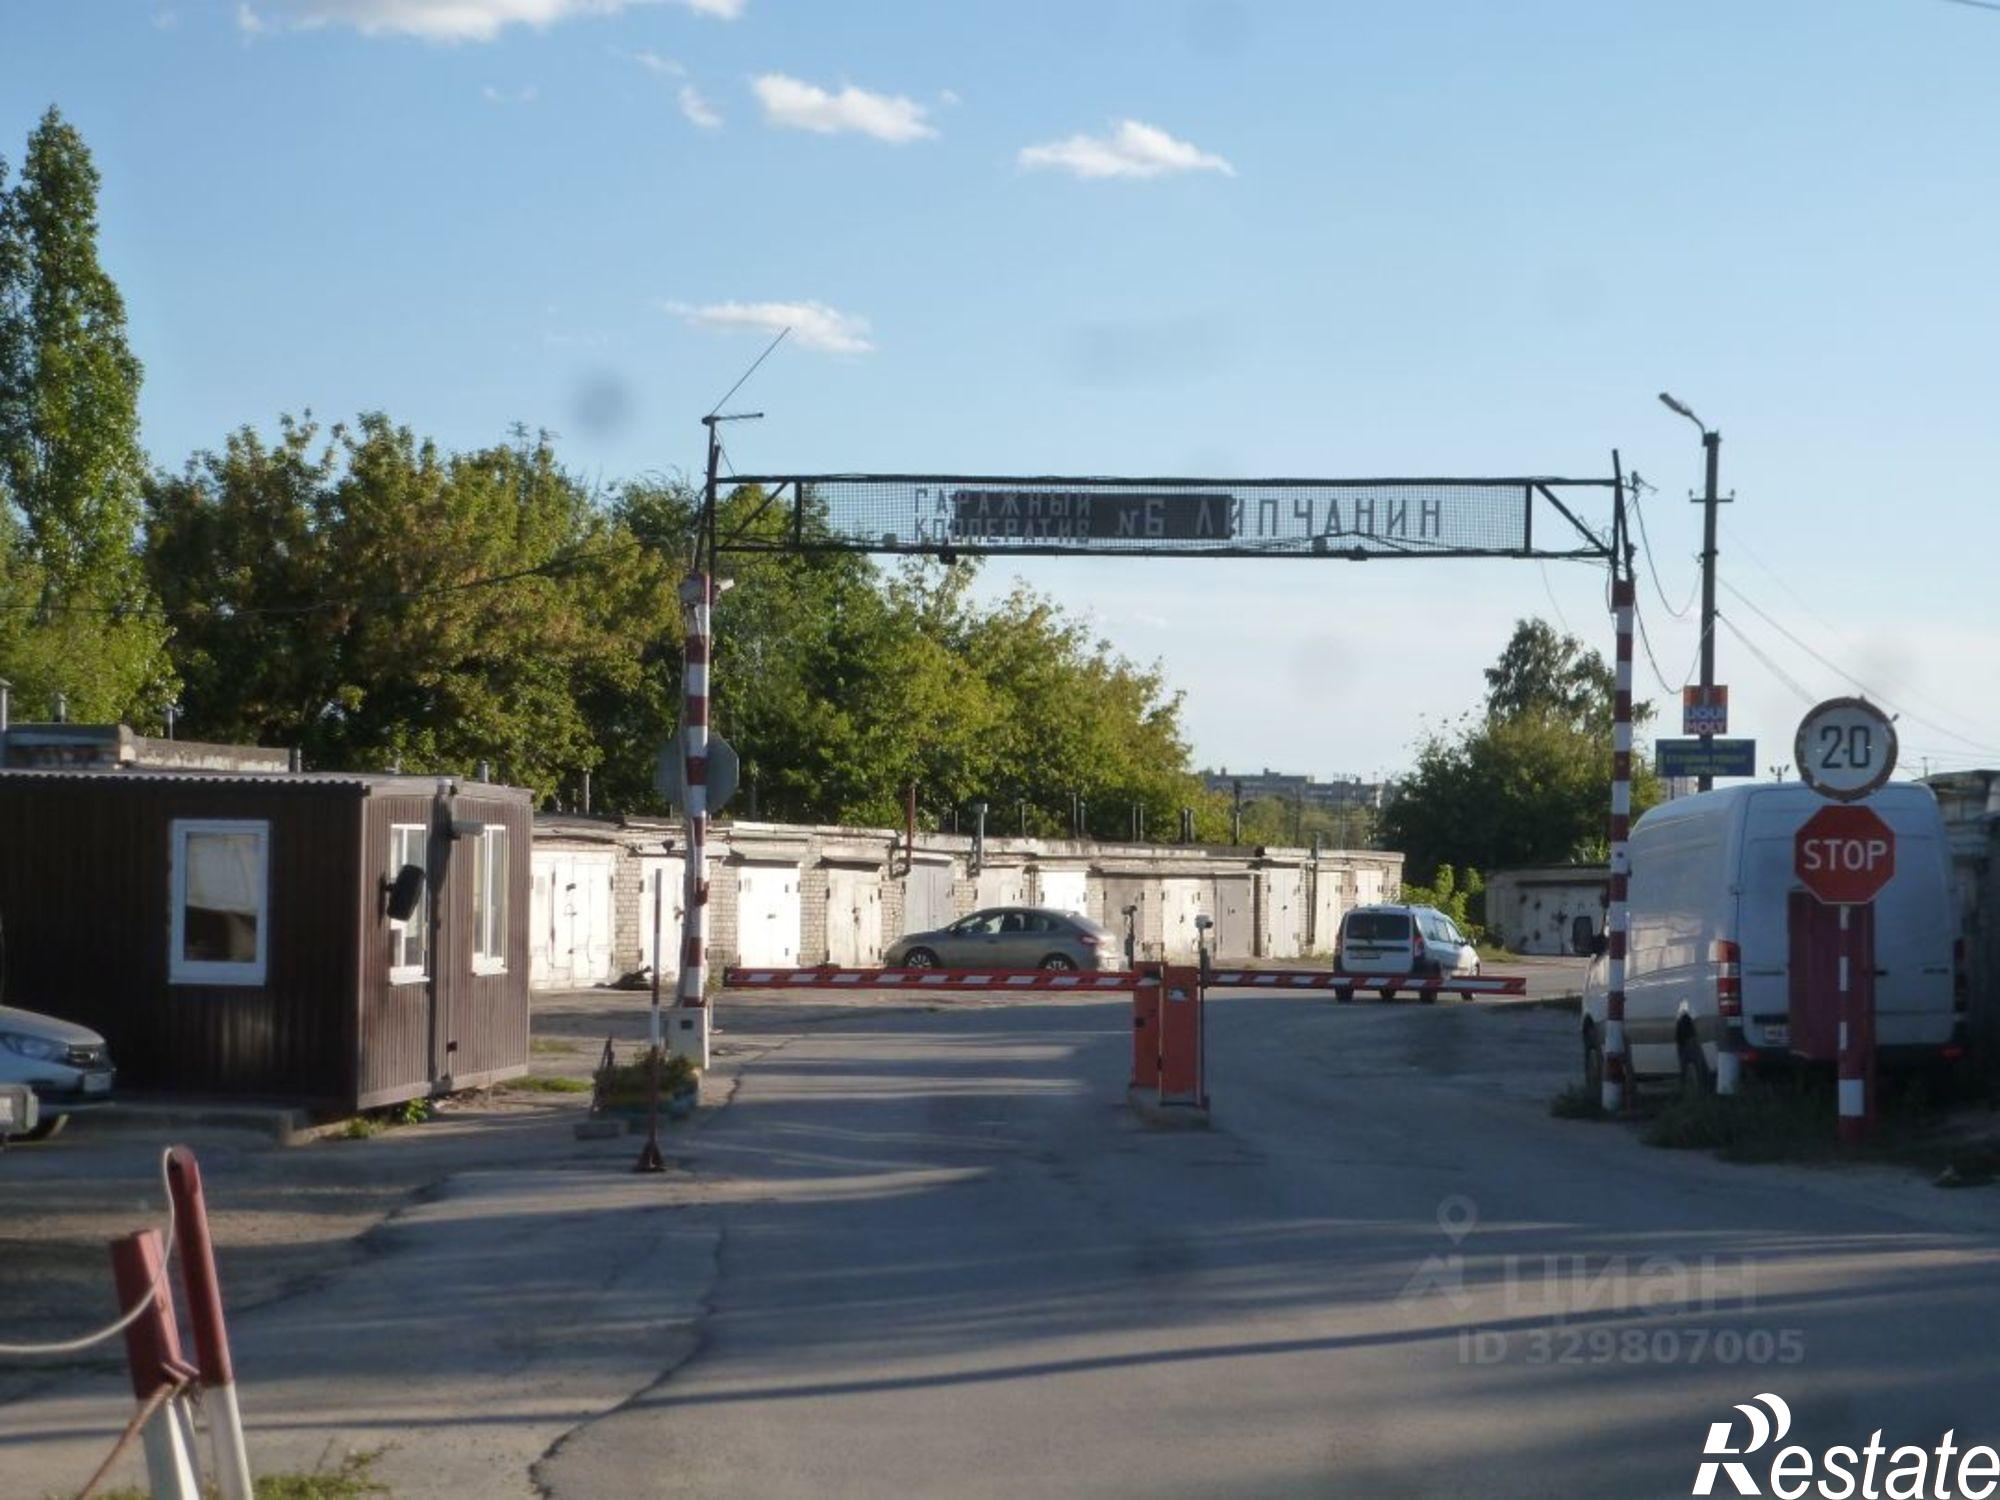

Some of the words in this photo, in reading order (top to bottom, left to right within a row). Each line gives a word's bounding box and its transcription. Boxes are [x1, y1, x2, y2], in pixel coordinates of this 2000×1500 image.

[914, 516, 1091, 544] КООПЕРАТИВ
[1195, 497, 1440, 538] ЛИПЧАНИН
[1819, 725, 1872, 770] 20
[1803, 839, 1888, 871] STOP
